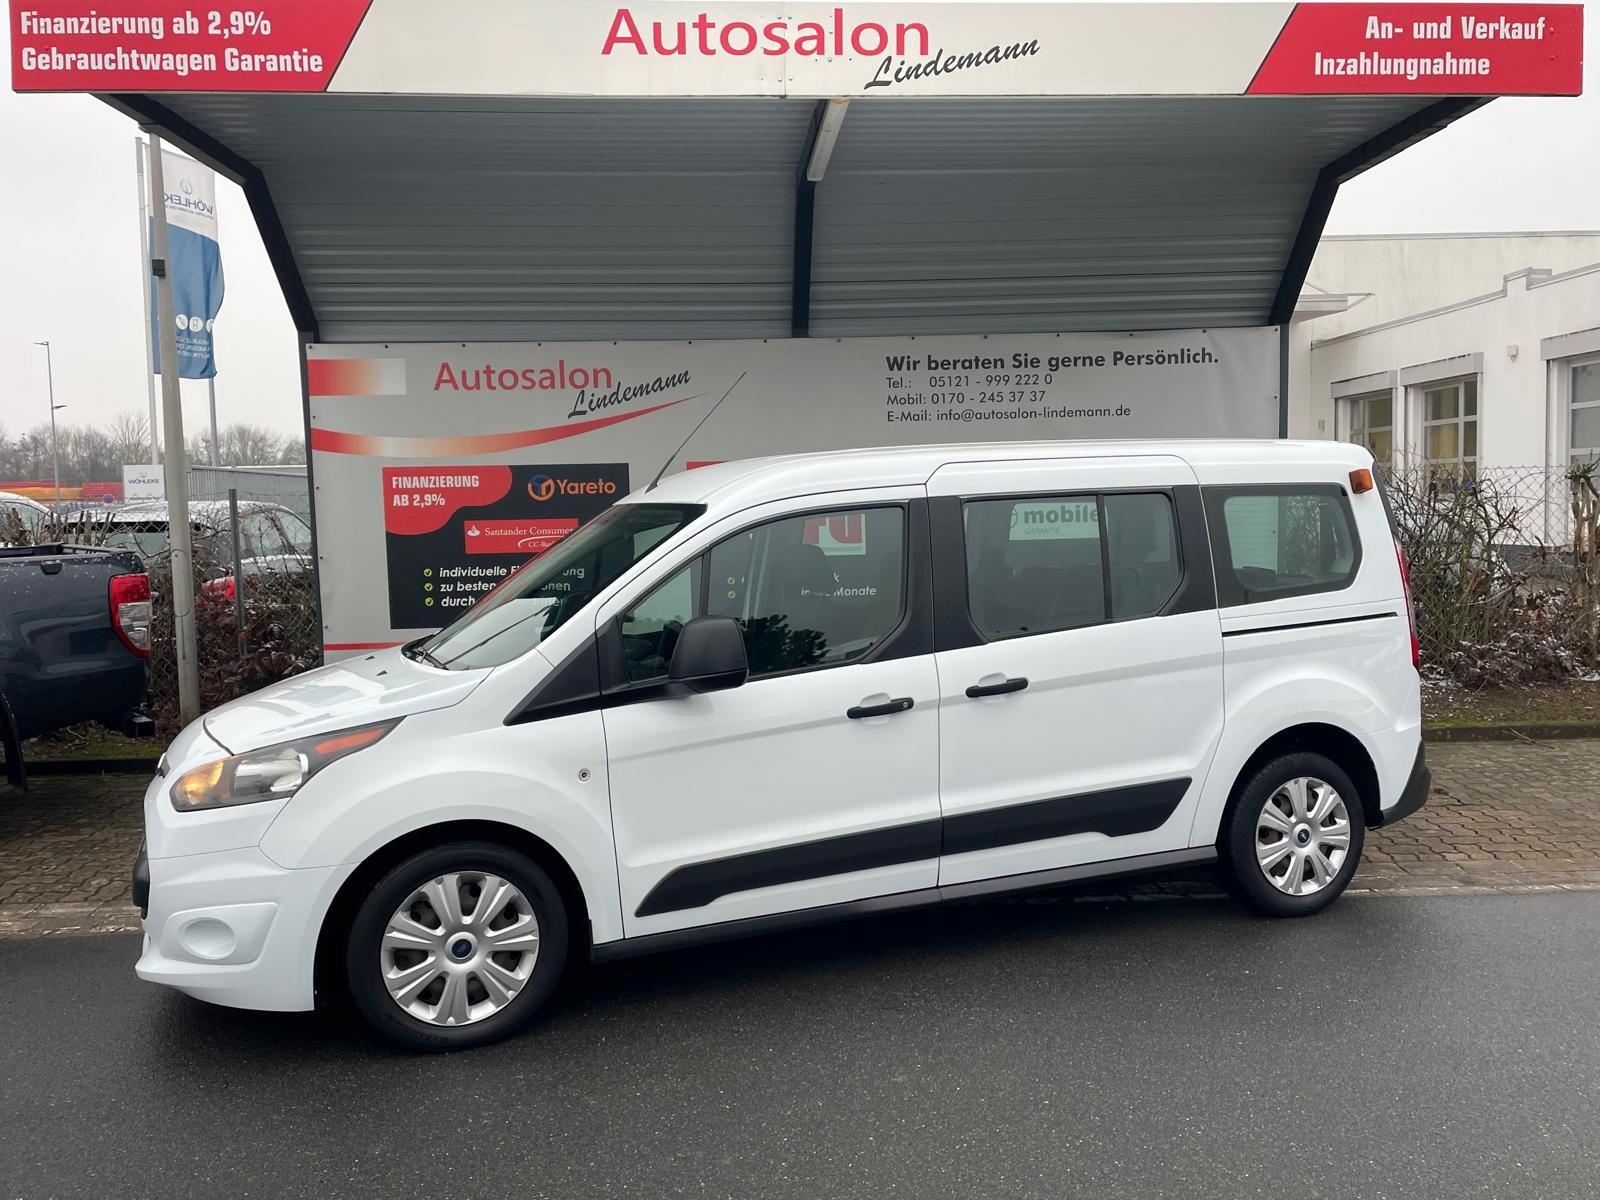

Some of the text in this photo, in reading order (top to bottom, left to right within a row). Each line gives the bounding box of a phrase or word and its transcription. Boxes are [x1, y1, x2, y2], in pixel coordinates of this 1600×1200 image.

[20, 11, 271, 39] Finanzierung ab 2,9%
[601, 8, 929, 56] Autosalon
[1365, 16, 1545, 40] An- und Verkauf
[22, 47, 323, 76] Gebrauchtwagen Garantie
[864, 37, 1040, 90] Lindemann
[1315, 52, 1490, 81] Inzahlungnahme
[886, 347, 1219, 372] Wir beraten Sie gerne Persönlich.
[433, 360, 613, 391] Autosalon
[886, 377, 912, 389] Tel.:
[929, 375, 970, 388] 05121
[985, 374, 1010, 387] 999
[1014, 374, 1040, 386] 222
[1044, 374, 1053, 386] 0
[567, 368, 691, 419] Lindemann
[886, 393, 926, 406] Mobil:
[931, 392, 965, 405] 0170
[978, 391, 1004, 404] 245
[1008, 391, 1025, 403] 37
[1029, 390, 1046, 402] 37
[887, 405, 1132, 422] E-Mail: info@autosalon-lindemann.de
[391, 475, 479, 489] FINANZIERUNG
[557, 478, 616, 495] Yareto
[392, 493, 446, 508] AB 2,9%
[1024, 505, 1099, 524] mobile
[485, 527, 527, 536] Santander
[439, 566, 507, 577] individuelle
[440, 584, 453, 592] zu
[441, 596, 476, 607] durch
